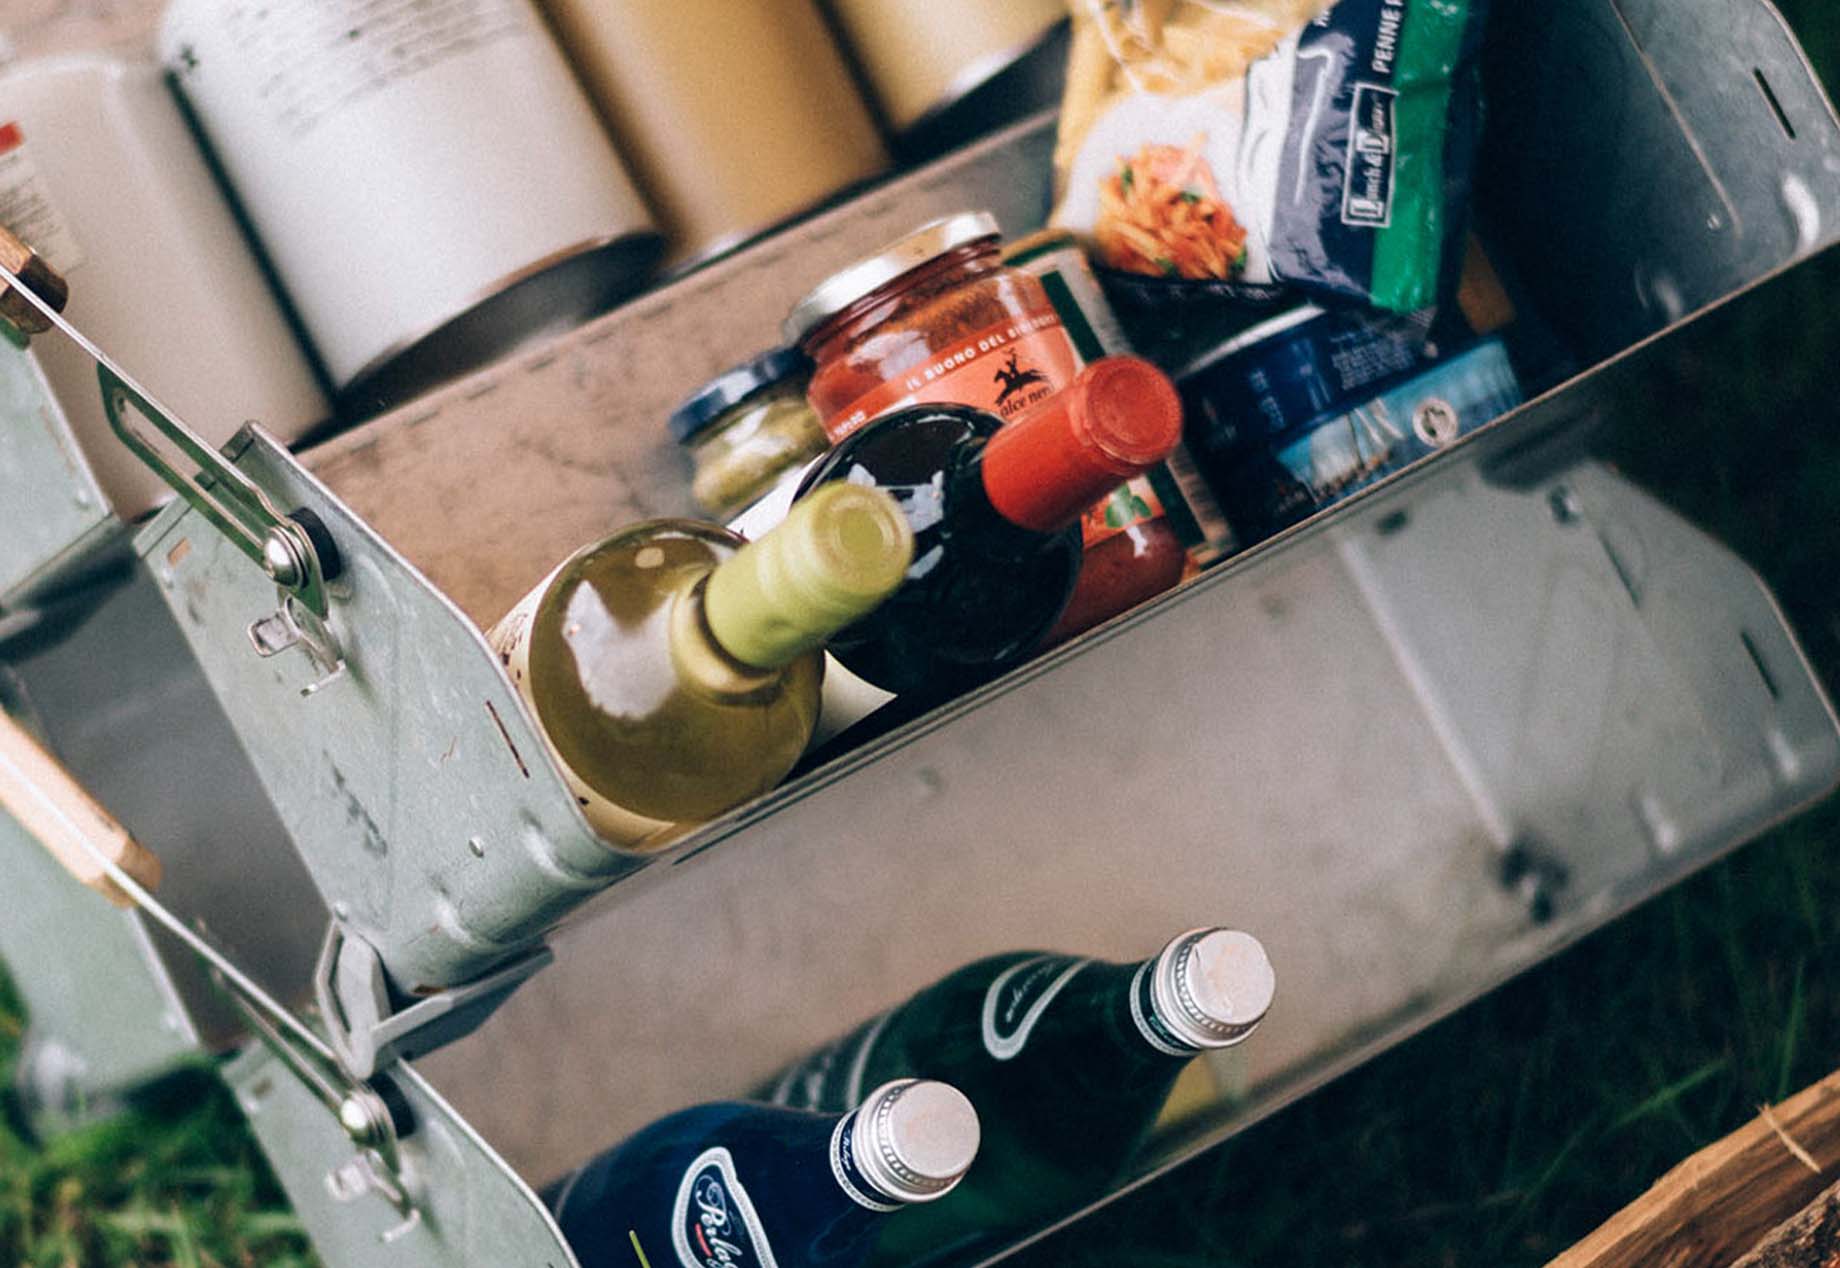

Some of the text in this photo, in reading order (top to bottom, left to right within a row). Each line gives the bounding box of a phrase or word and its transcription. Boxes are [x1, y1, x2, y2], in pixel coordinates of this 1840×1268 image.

[1371, 8, 1401, 74] PENNE
[906, 333, 1006, 392] IL BUONO DEL
